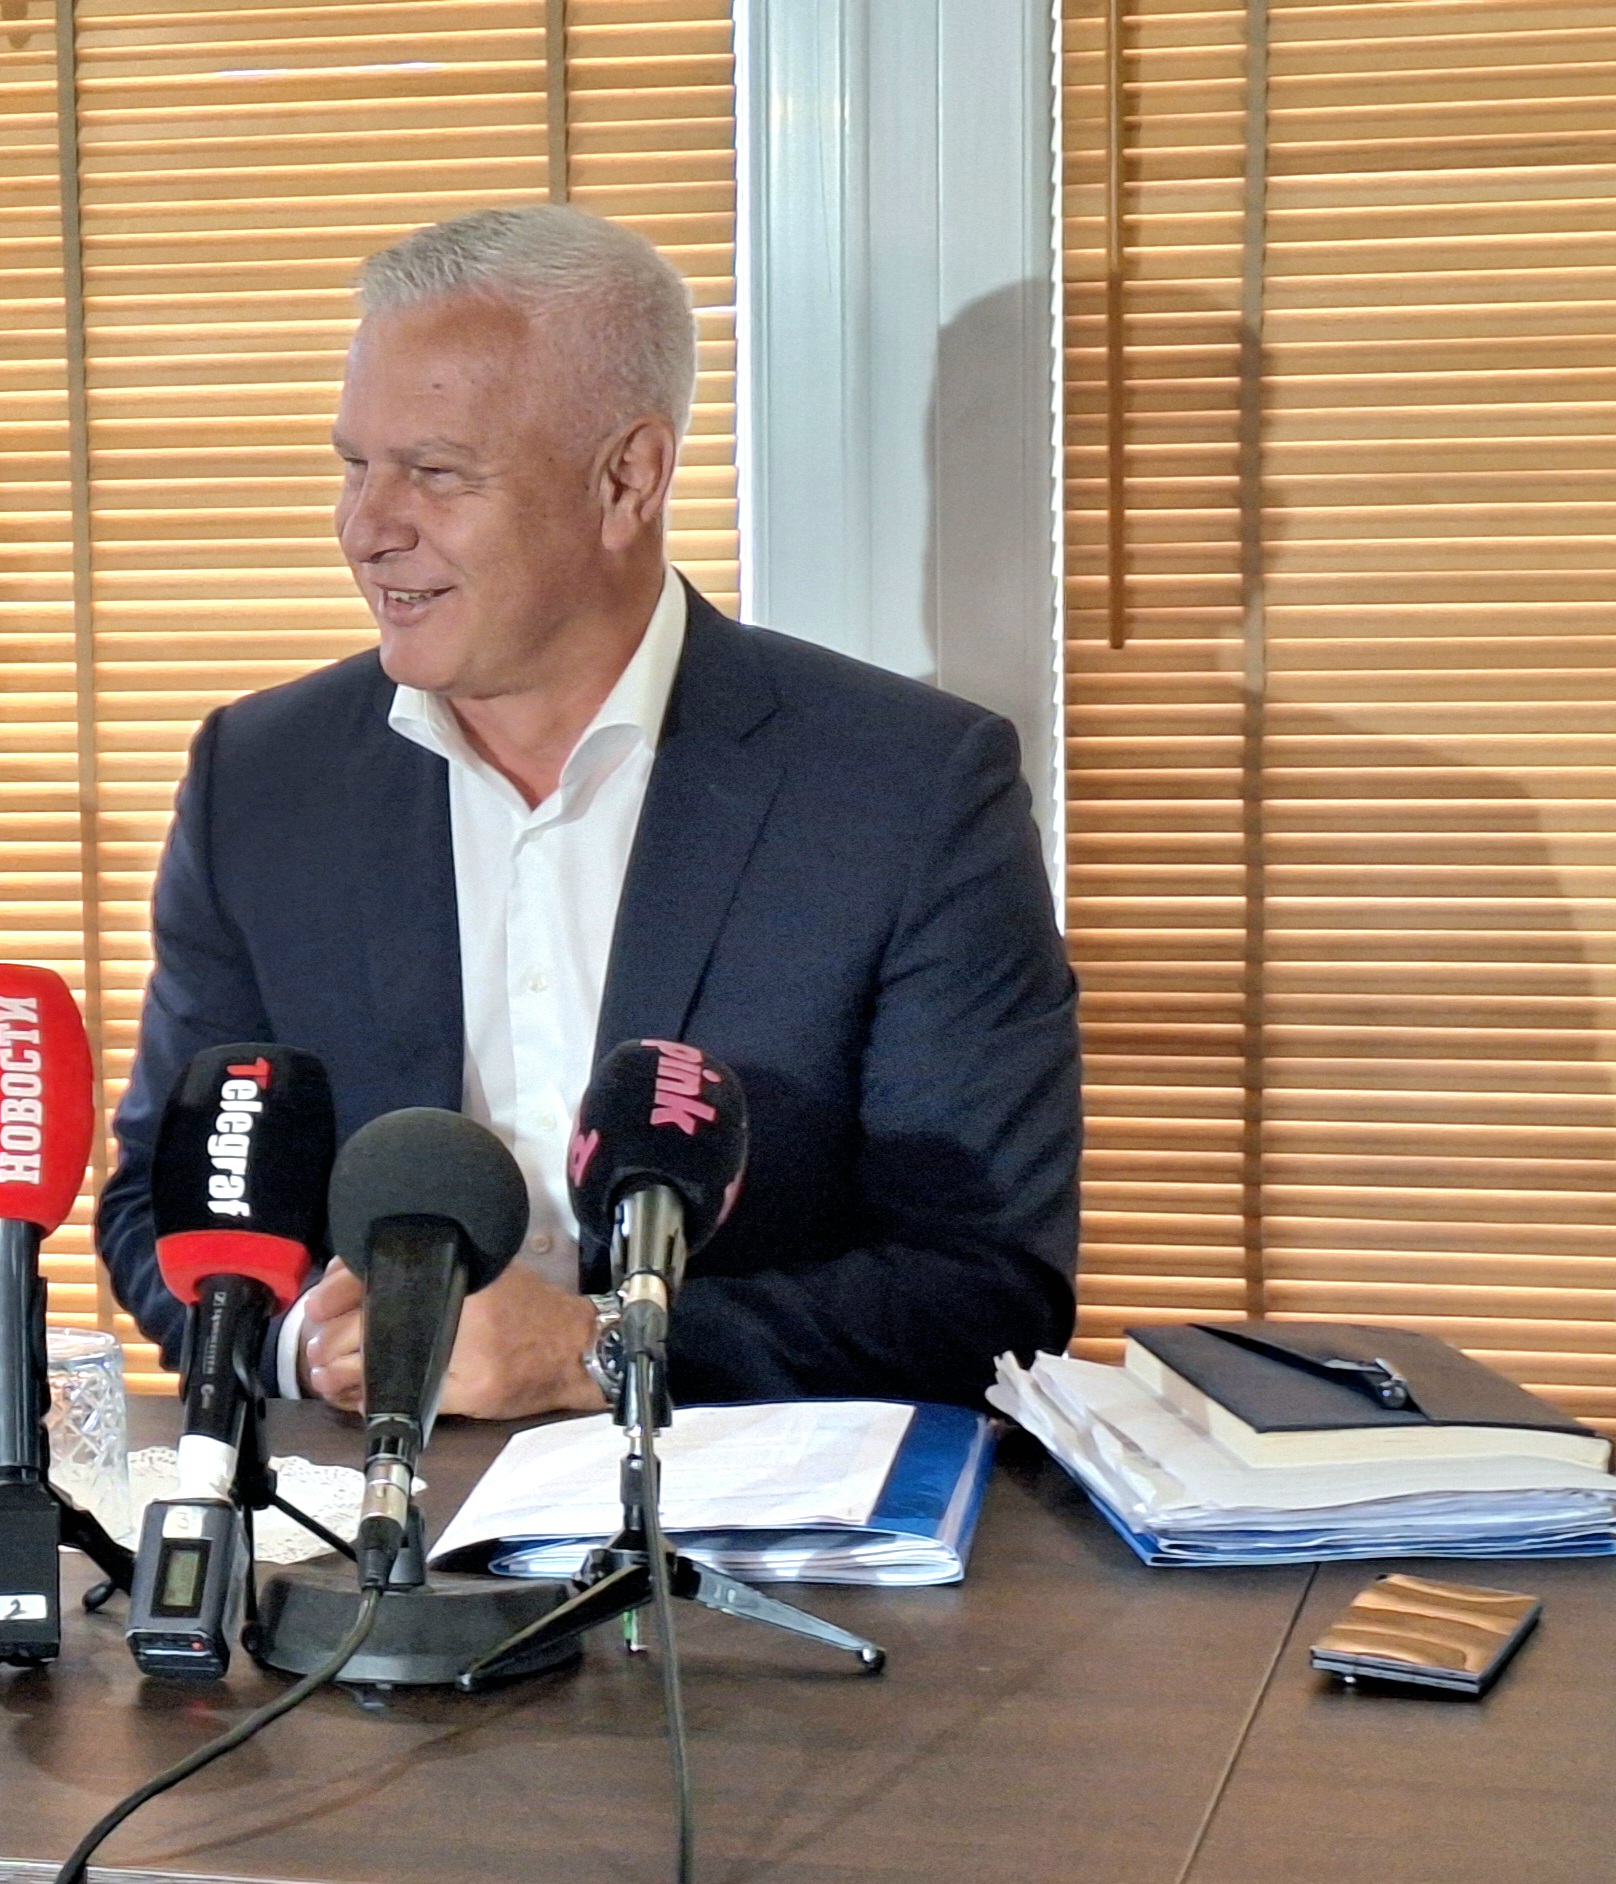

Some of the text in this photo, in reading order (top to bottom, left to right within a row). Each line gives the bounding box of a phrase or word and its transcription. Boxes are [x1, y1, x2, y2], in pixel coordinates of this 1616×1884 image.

[640, 1038, 722, 1136] pink
[207, 1056, 272, 1217] Telegraf
[4, 1598, 28, 1619] 2
